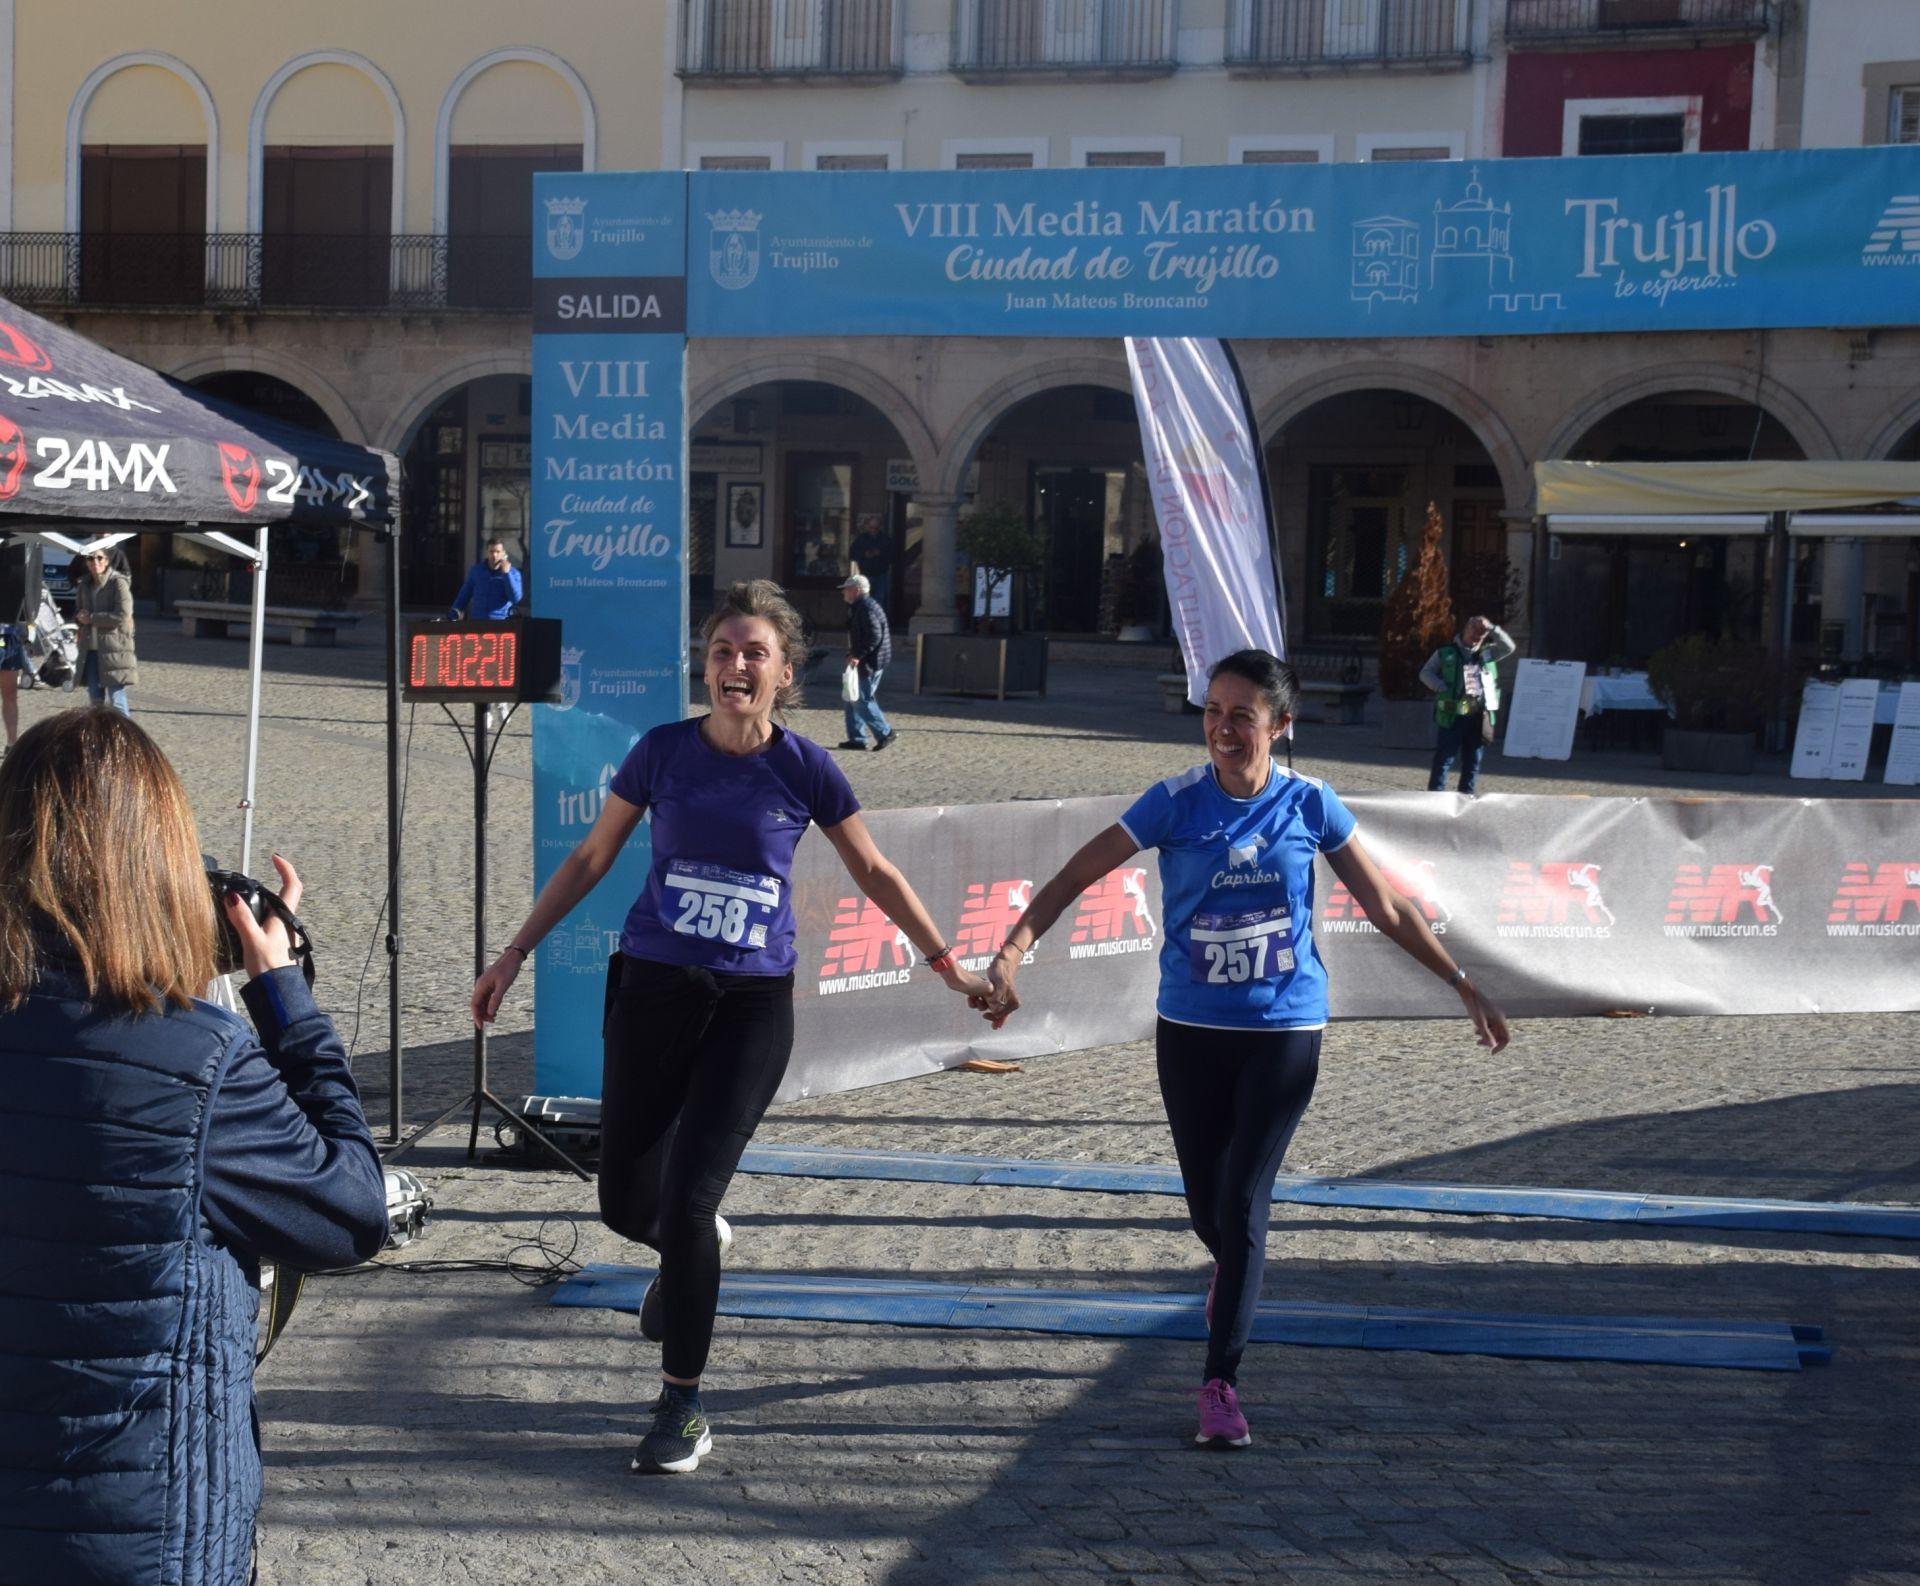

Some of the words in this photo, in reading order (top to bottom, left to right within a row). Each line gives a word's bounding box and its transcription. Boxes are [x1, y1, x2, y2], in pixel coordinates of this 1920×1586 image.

[591, 216, 659, 228] Ayuntamiento
[660, 215, 673, 226] de
[894, 203, 980, 237] VIII
[993, 200, 1123, 237] Media
[1136, 198, 1315, 236] Maratón
[590, 227, 646, 245] Trujillo
[769, 235, 855, 252] Ayuntamiento
[857, 235, 873, 248] de
[1564, 184, 1777, 278] Trujillo
[768, 251, 840, 274] Trujillo
[945, 244, 1077, 281] Ciudad
[1085, 245, 1134, 280] de
[1144, 240, 1279, 294] Trujillo
[1614, 269, 1638, 298] te
[557, 294, 662, 319] SALIDA
[1005, 292, 1046, 313] Juan
[1052, 293, 1117, 309] Mateos
[1123, 292, 1208, 309] Broncano
[559, 361, 650, 398] VIII
[552, 412, 667, 440] Media
[33, 437, 177, 493] 24MX
[544, 456, 675, 481] Maratón
[560, 493, 628, 514] Ciudad
[630, 495, 656, 514] de
[543, 518, 671, 572] Trujillo
[549, 576, 573, 588] Juan
[576, 577, 613, 587] Mateos
[617, 577, 667, 587] Broncano
[589, 667, 659, 680] Ayuntamiento
[660, 667, 673, 677] de
[588, 680, 647, 699] Trujillo
[674, 891, 749, 943] 258
[1663, 922, 1778, 937] www.musicrun.es
[1497, 921, 1611, 939] www.musicrun.es
[1069, 936, 1153, 960] www.musicrun.es
[1204, 935, 1269, 983] 257
[819, 967, 911, 996] www.musicrun.es
